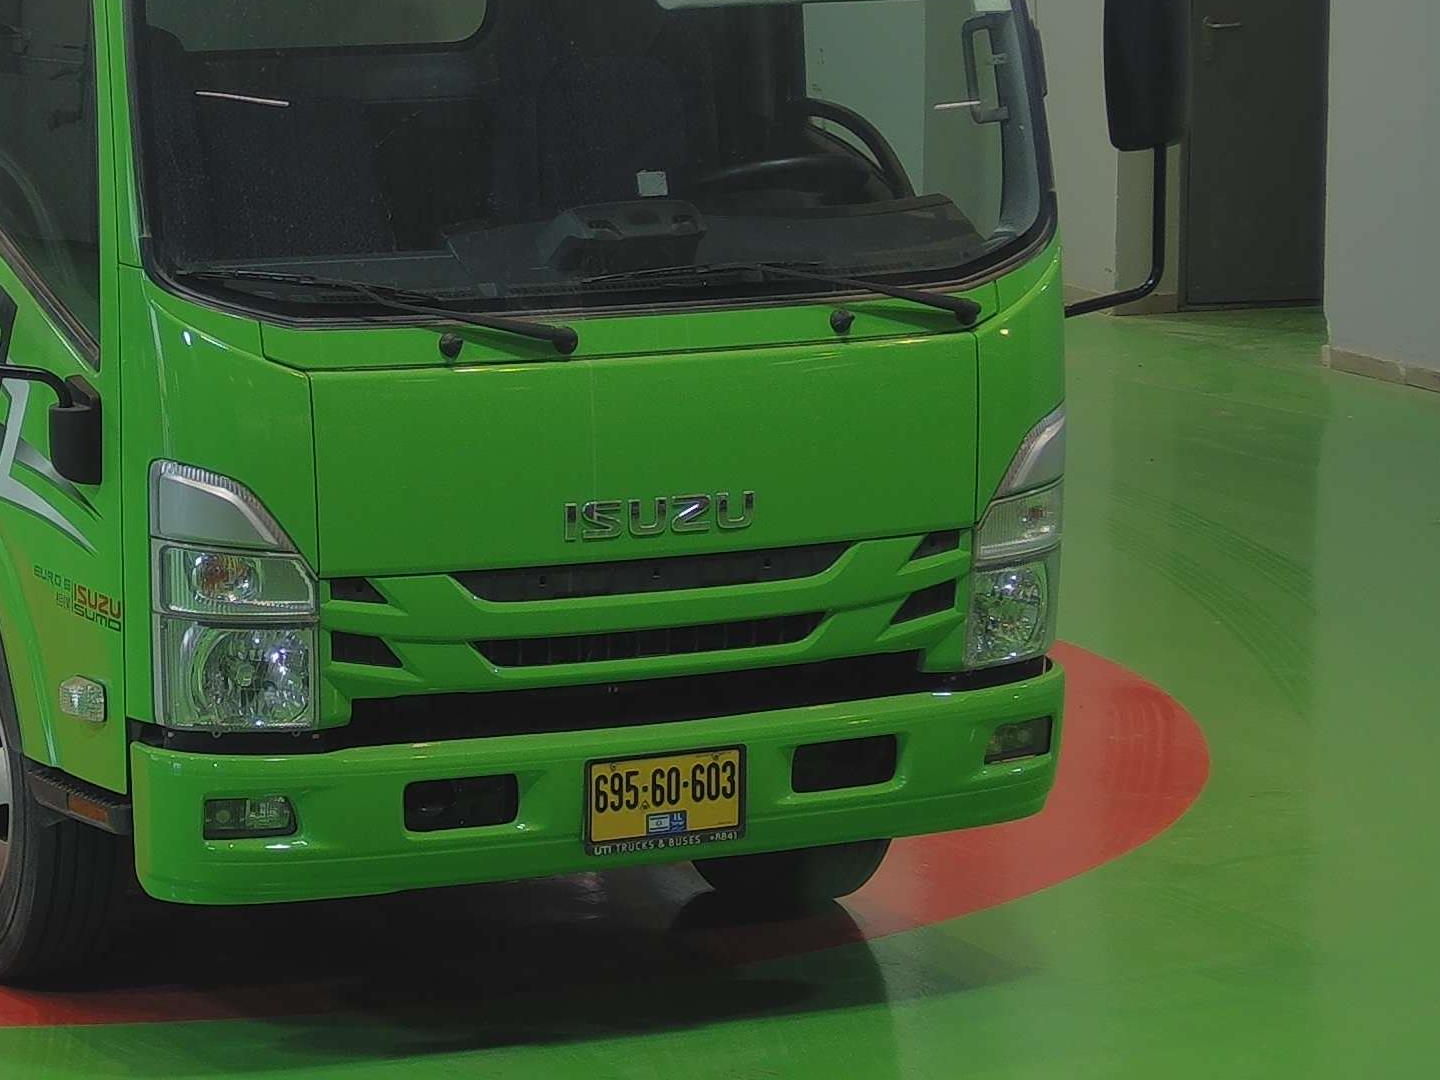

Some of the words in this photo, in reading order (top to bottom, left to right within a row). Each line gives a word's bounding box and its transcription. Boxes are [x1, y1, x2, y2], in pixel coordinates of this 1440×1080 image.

[564, 490, 755, 541] ISUZU
[74, 583, 121, 619] ISUZU
[74, 603, 121, 632] SUMO
[616, 839, 654, 853] TRUCKS
[657, 838, 665, 848] &
[669, 835, 701, 847] BUSES
